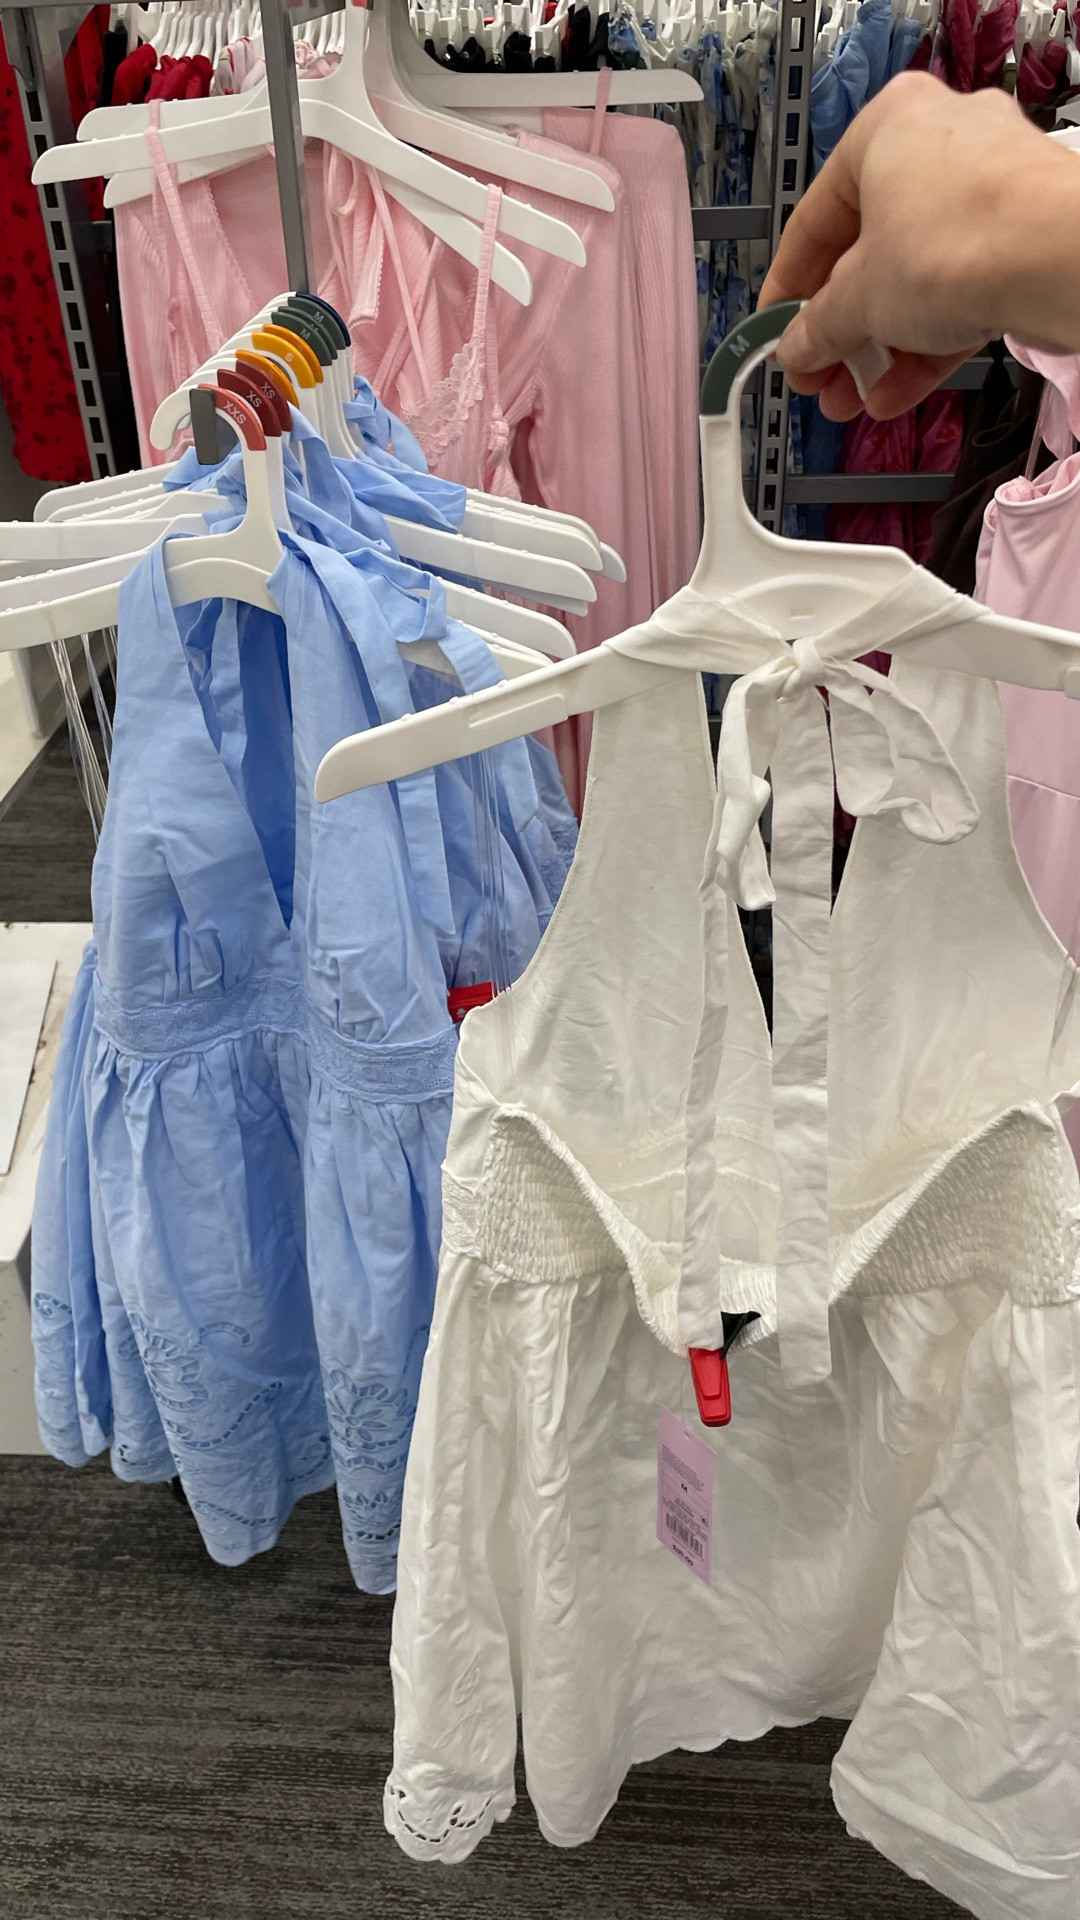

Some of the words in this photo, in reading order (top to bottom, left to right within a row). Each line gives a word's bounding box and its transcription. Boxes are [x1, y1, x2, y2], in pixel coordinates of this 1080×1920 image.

[313, 311, 325, 324] M
[300, 328, 311, 340] M
[729, 334, 750, 357] M
[245, 390, 262, 408] XS
[260, 382, 275, 399] XS
[223, 400, 247, 425] XXS
